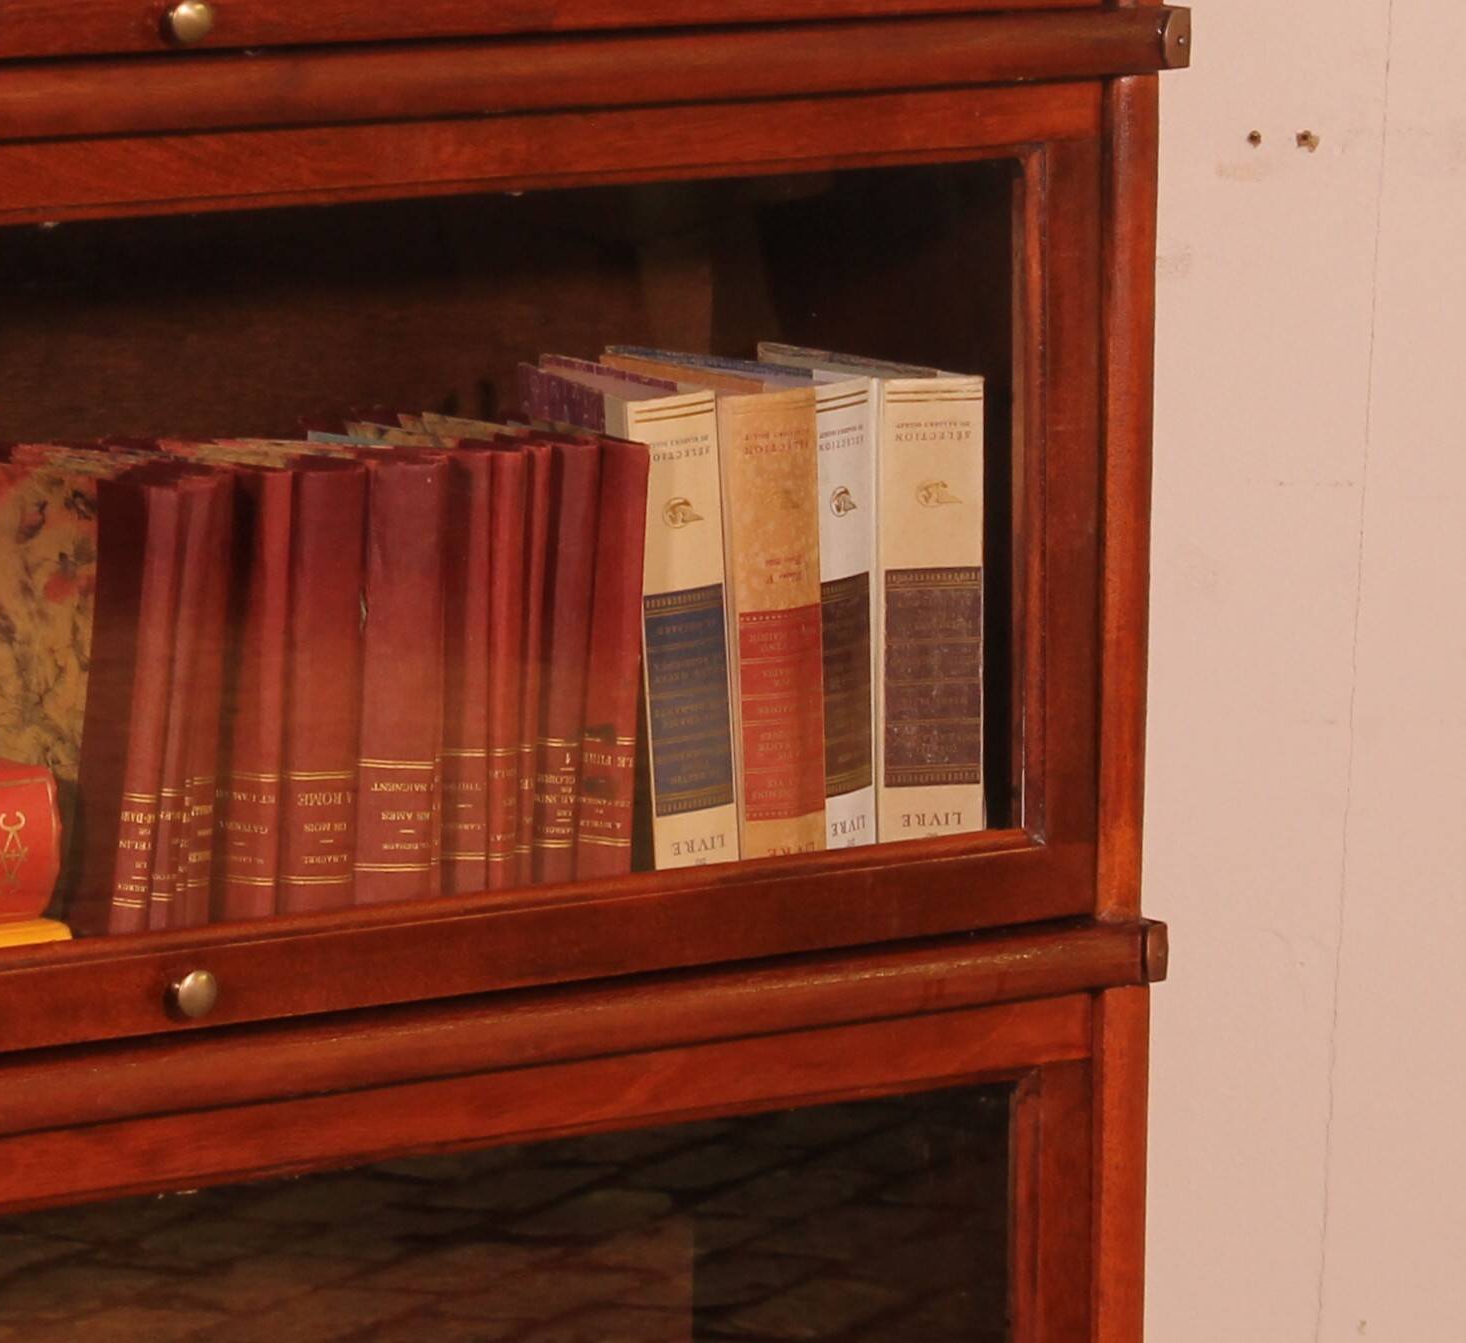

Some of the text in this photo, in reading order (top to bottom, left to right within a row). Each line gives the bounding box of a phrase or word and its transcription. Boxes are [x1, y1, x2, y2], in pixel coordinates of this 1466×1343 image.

[818, 434, 864, 452] SÉLECTION
[894, 431, 971, 442] SÉLECTION
[370, 781, 427, 792] SAIGNENT
[296, 792, 343, 806] ROME
[380, 811, 413, 821] AMES
[900, 811, 962, 827] LIVRE
[830, 814, 865, 837] LIVRE
[671, 834, 724, 856] LIVRE
